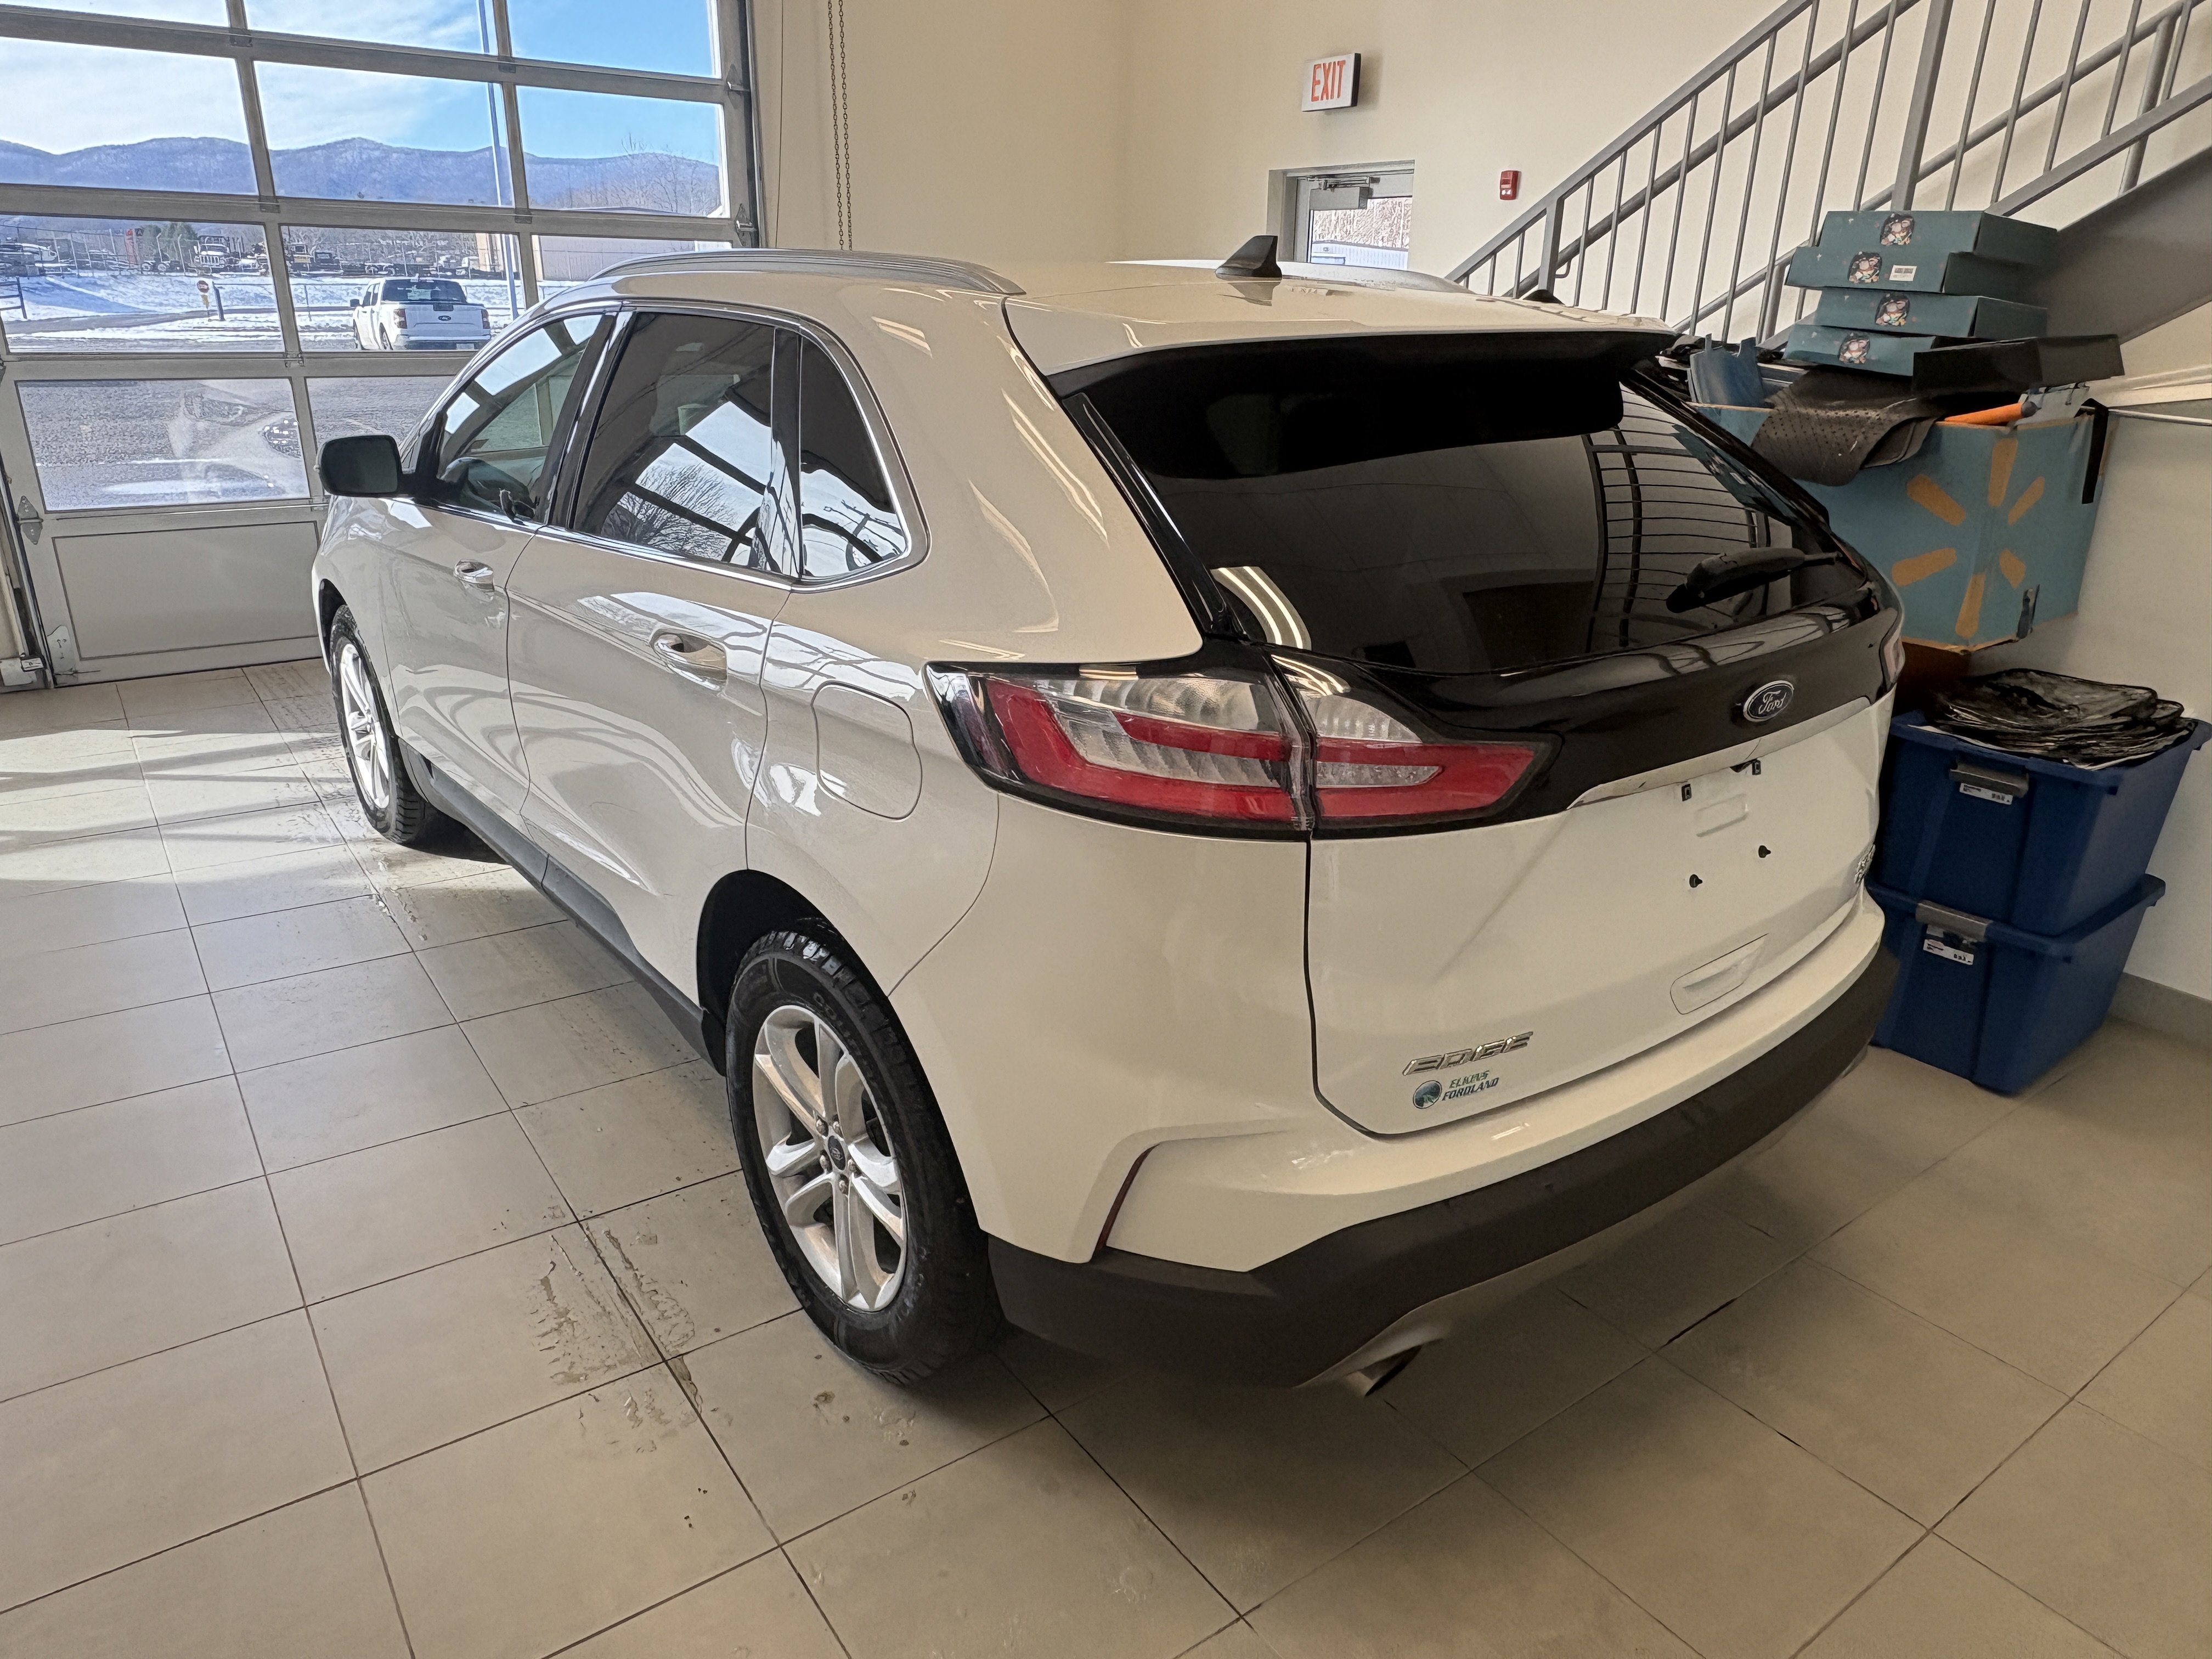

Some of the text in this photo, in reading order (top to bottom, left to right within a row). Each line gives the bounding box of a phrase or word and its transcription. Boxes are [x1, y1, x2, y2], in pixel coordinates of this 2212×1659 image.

[1311, 60, 1346, 102] EXIT
[1758, 690, 1787, 714] Ford
[1402, 1031, 1533, 1076] EDGE
[1442, 1077, 1499, 1101] FORDLAND
